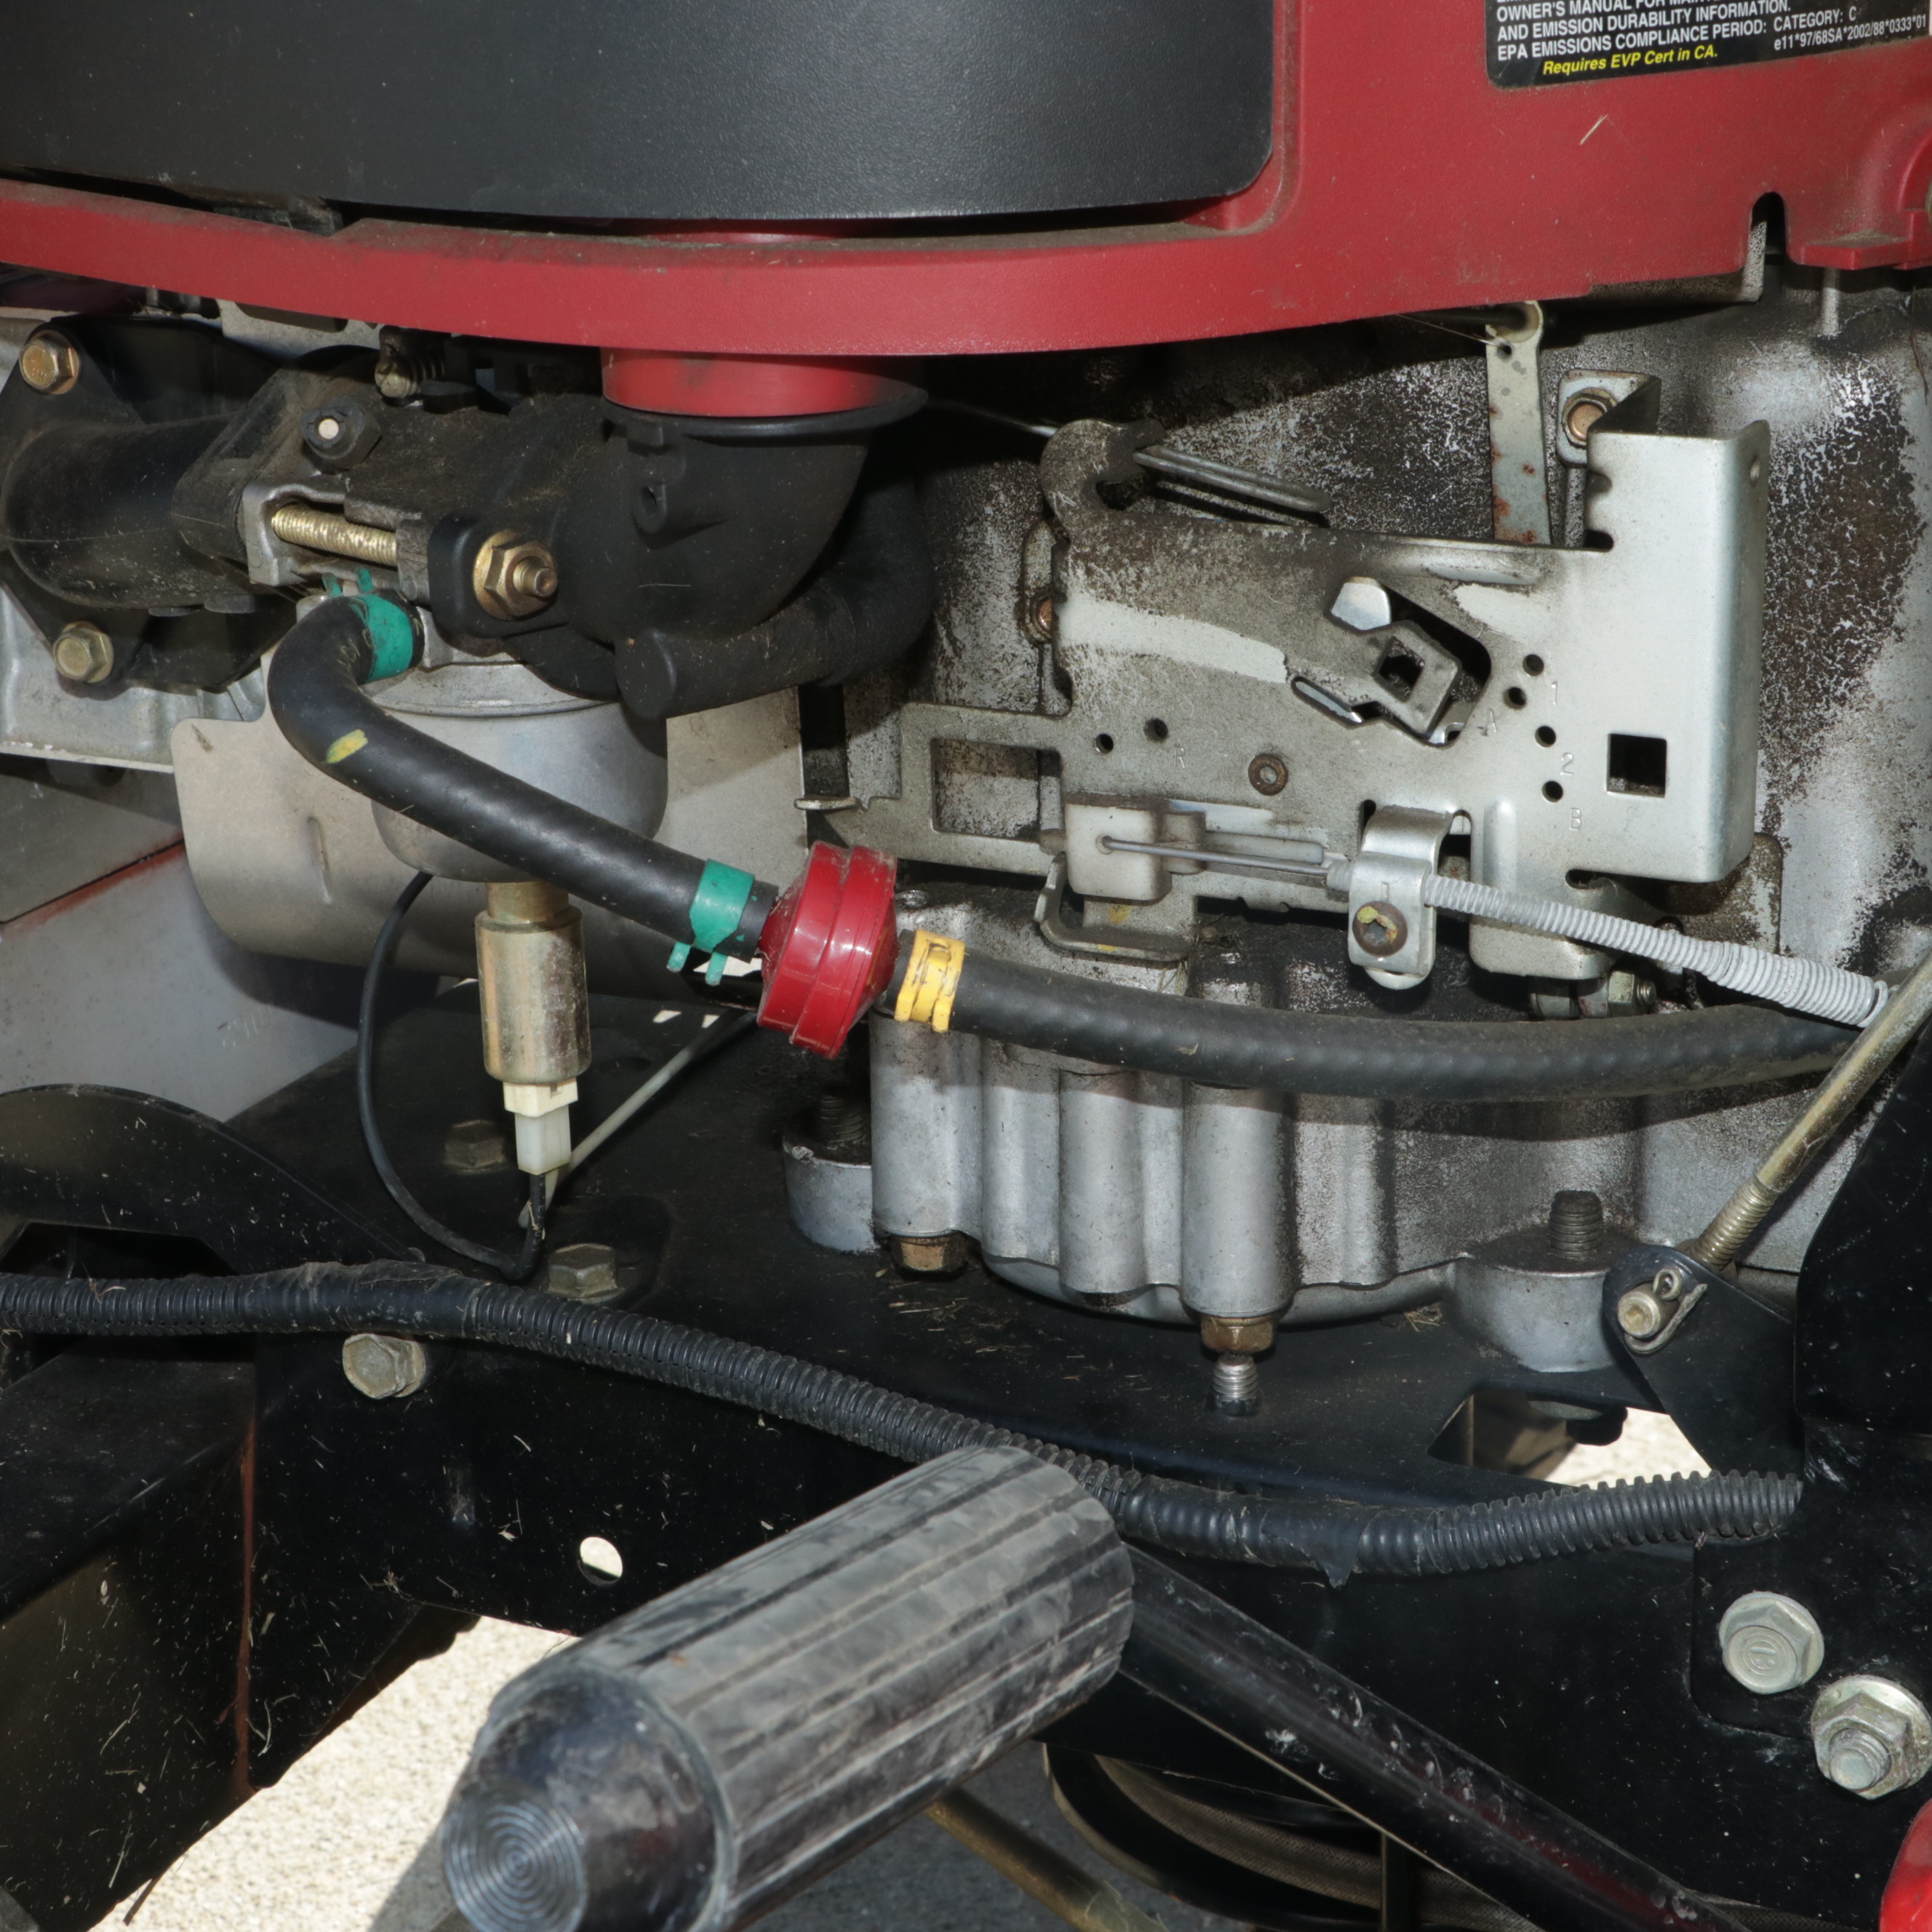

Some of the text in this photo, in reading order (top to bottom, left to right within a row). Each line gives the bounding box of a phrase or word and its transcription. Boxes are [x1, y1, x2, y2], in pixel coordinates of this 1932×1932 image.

[1496, 1, 1565, 22] OWNER'S
[1570, 0, 1632, 15] MANUAL
[1498, 0, 1791, 41] AND EMISSION DURABILITY INFORMATION.
[1498, 7, 1856, 61] EPA EMISSIONS COMPLIANCE PERIOD: CATEGORY: C
[1543, 44, 1717, 76] Requires EVP Cert in CA.
[1560, 752, 1574, 776] 2
[1569, 807, 1582, 831] B
